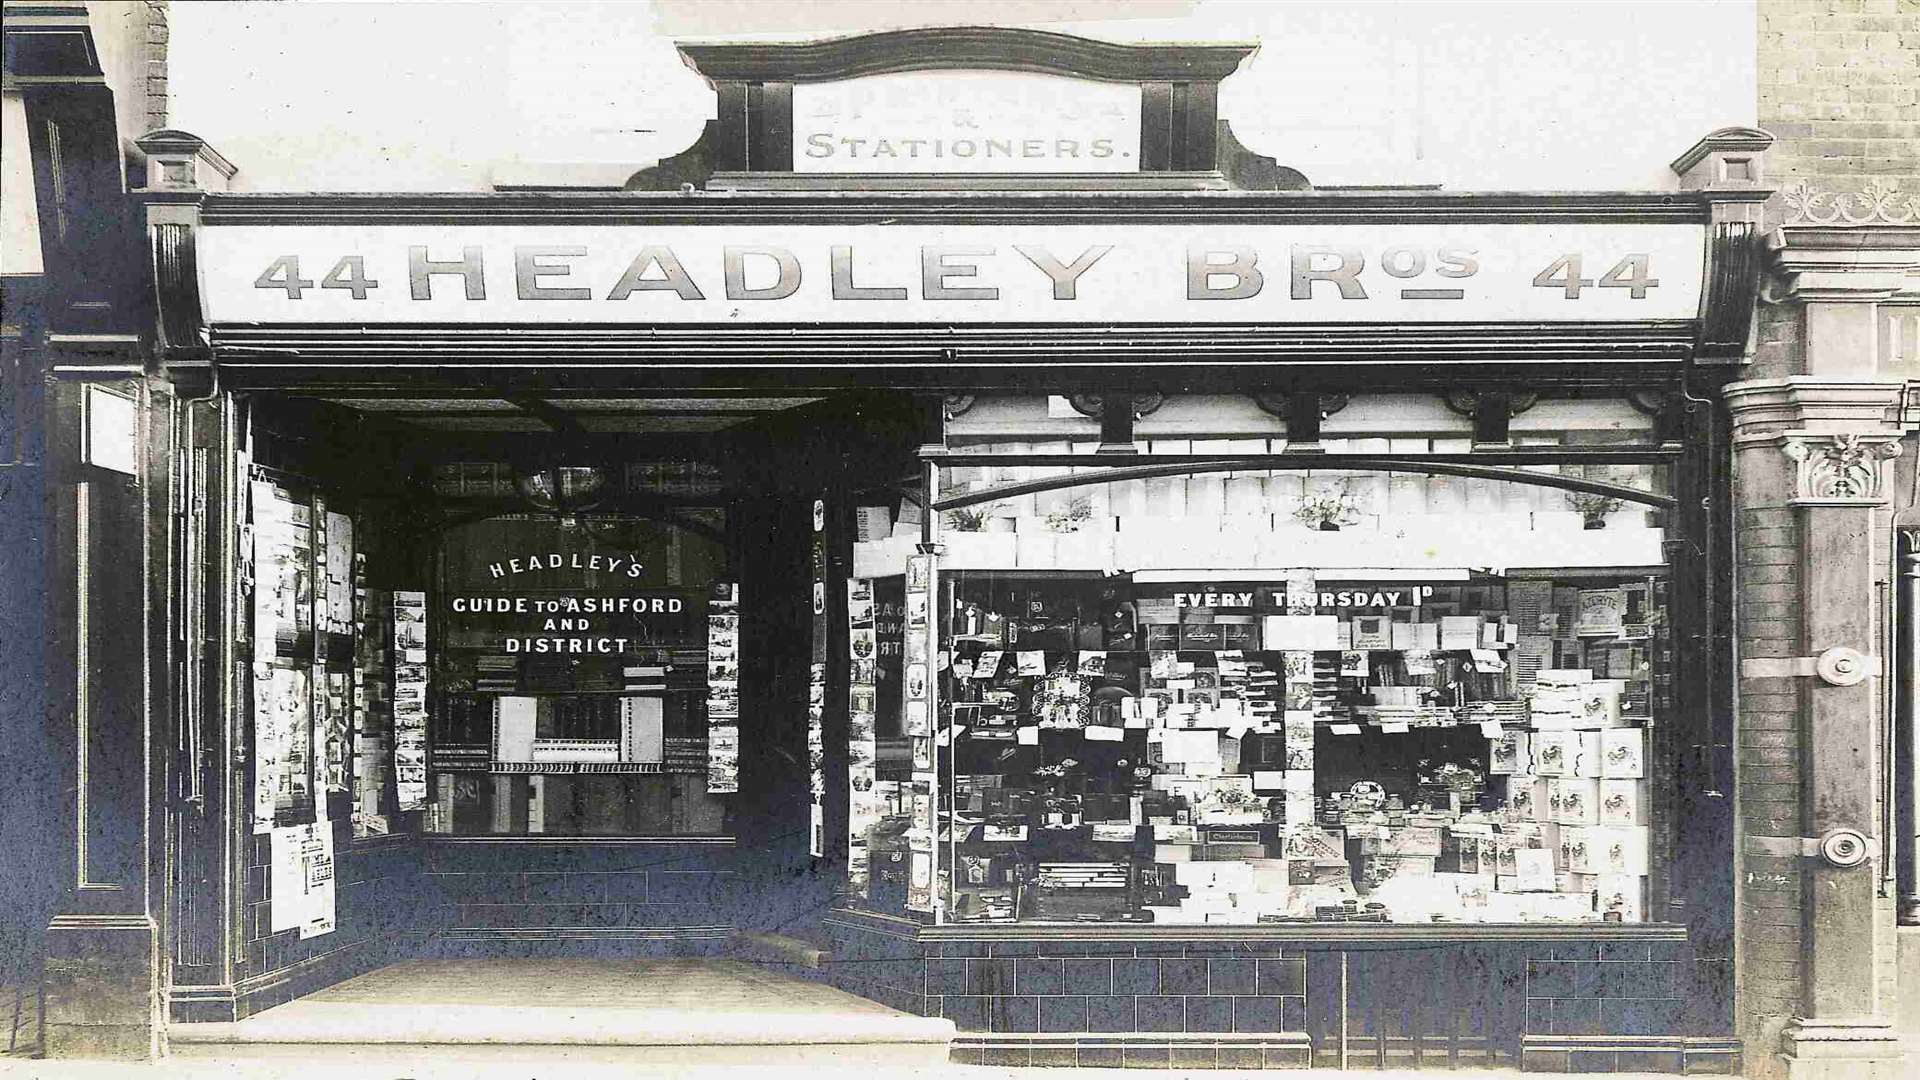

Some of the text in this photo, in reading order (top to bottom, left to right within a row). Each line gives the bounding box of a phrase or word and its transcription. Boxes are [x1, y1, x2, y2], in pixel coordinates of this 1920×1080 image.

[805, 132, 1131, 158] STATIONERS.
[254, 254, 378, 300] 44
[409, 245, 1115, 301] HEADLEY
[1532, 253, 1660, 300] 44
[489, 553, 643, 578] HEADLEY'S
[452, 598, 528, 613] GUIDE
[566, 597, 682, 613] ASHFORD
[1173, 592, 1254, 608] EVERY
[1272, 592, 1400, 608] THURSDAY
[543, 618, 589, 631] AND
[506, 638, 628, 653] DISTRICT
